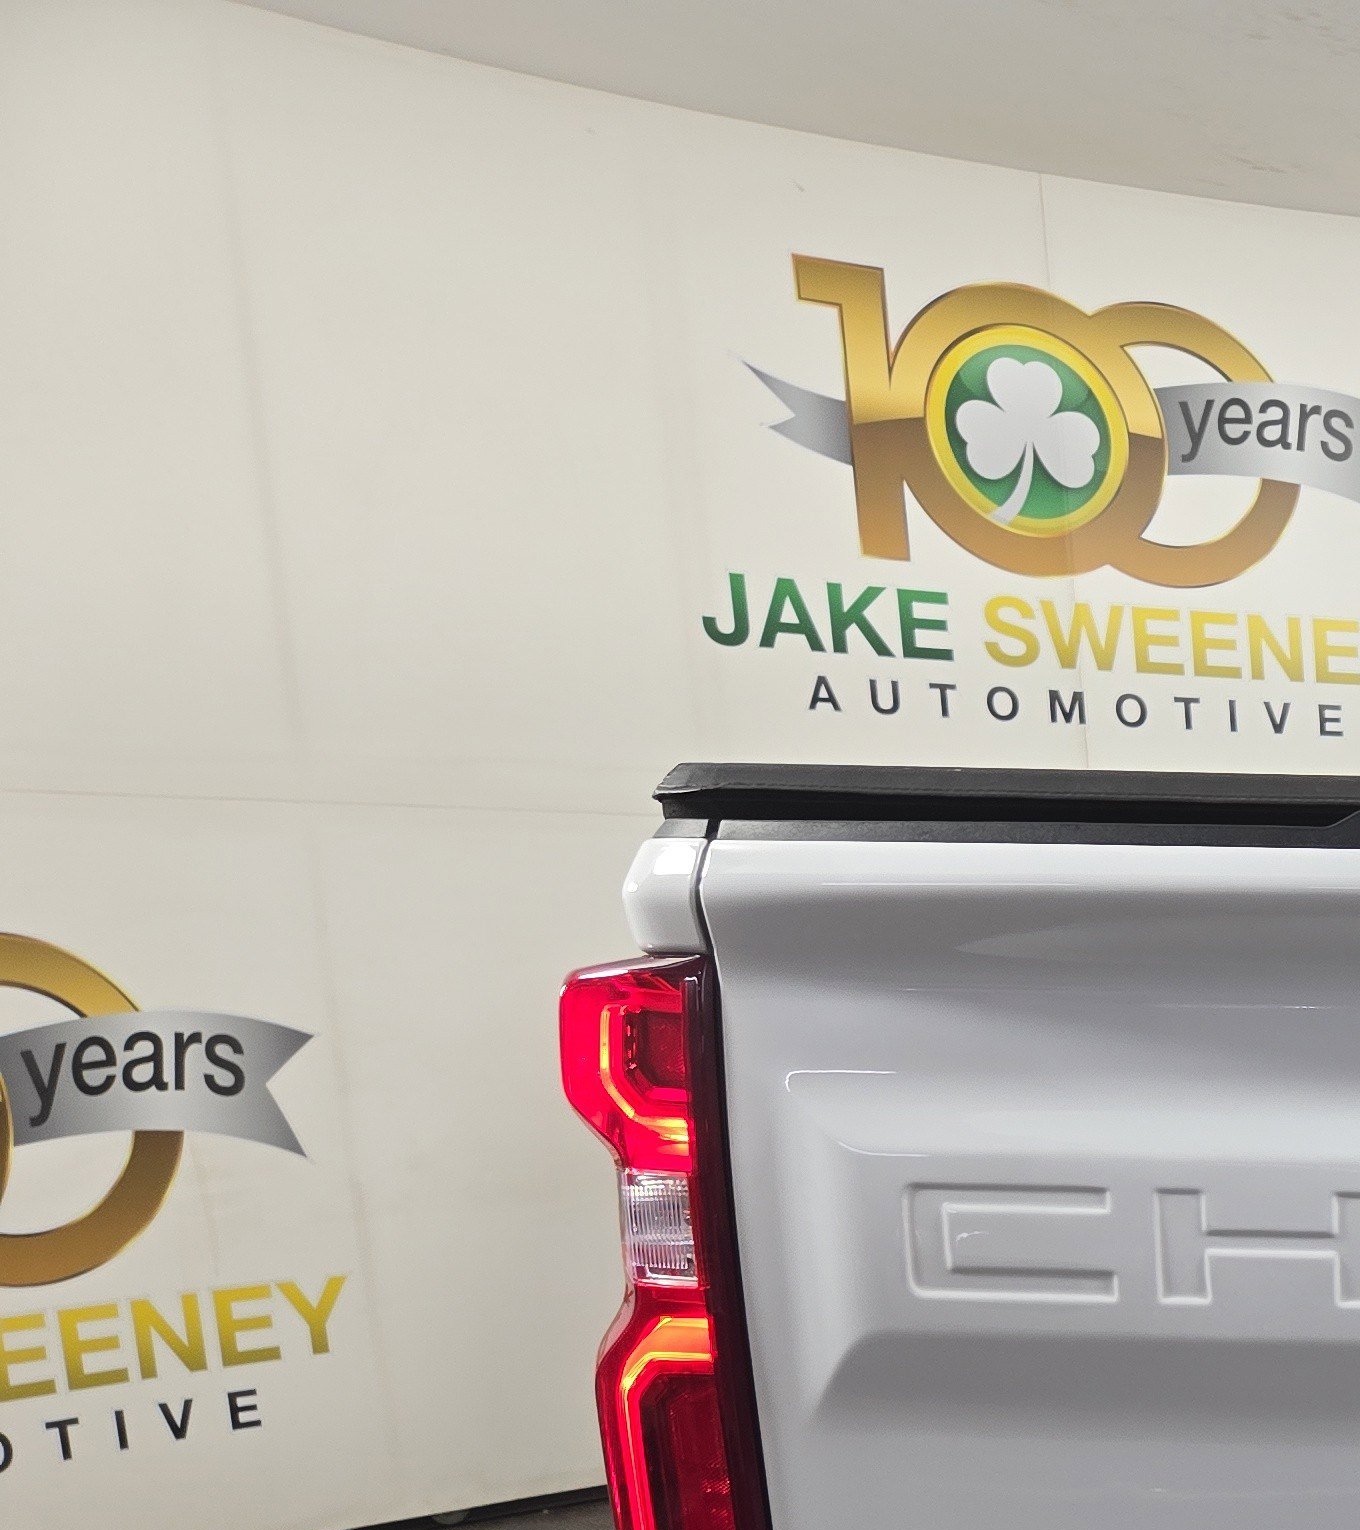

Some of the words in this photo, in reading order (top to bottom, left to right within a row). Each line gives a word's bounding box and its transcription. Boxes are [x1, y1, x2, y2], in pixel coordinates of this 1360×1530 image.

[1178, 396, 1355, 463] years
[702, 572, 954, 662] JAKE
[809, 675, 1345, 737] AUTOMOTIVE
[21, 1030, 246, 1127] years
